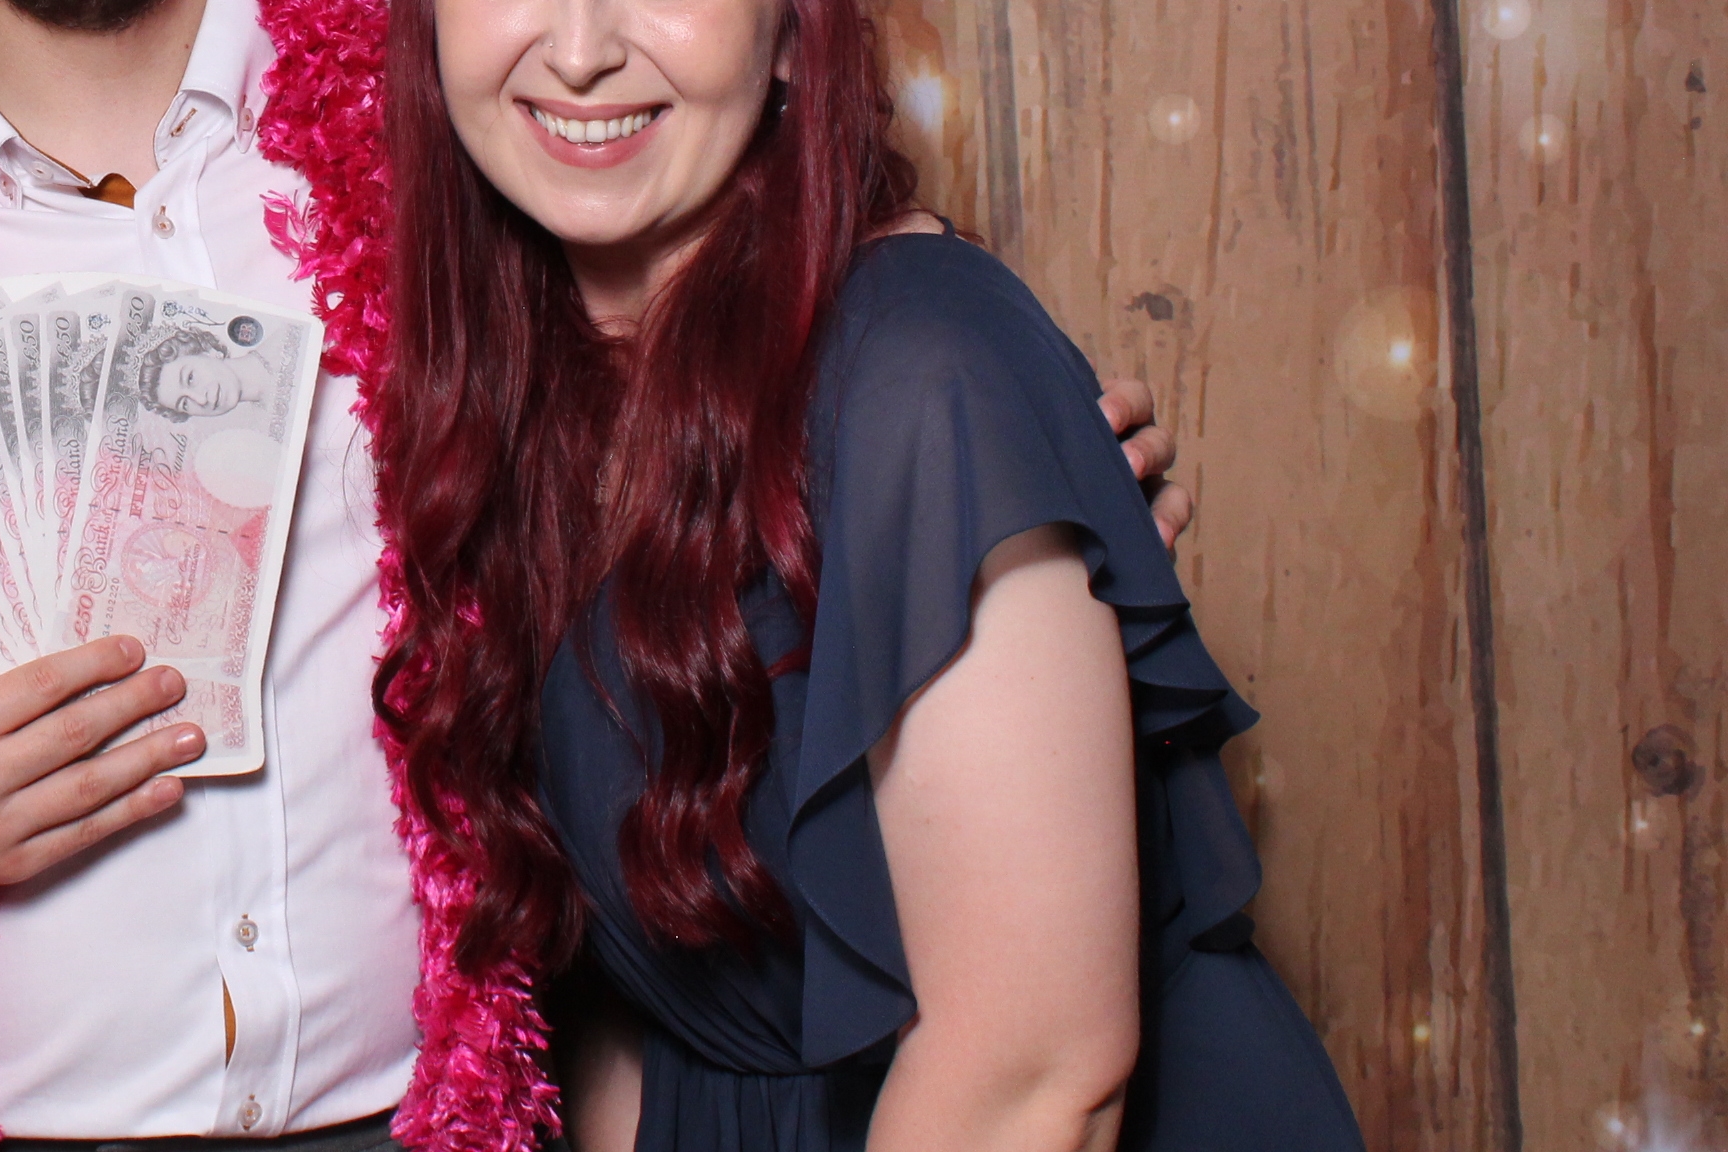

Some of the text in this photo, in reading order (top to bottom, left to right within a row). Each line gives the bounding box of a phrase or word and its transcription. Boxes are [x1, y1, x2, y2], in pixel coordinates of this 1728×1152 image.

[19, 319, 41, 366] £50
[55, 316, 73, 360] £50
[125, 295, 148, 343] £50
[91, 414, 130, 512] England
[129, 445, 152, 519] FIFTY
[153, 433, 188, 510] Pounds
[101, 510, 114, 528] of
[72, 518, 110, 593] Bank
[74, 593, 94, 643] £50
[107, 577, 120, 619] 202220
